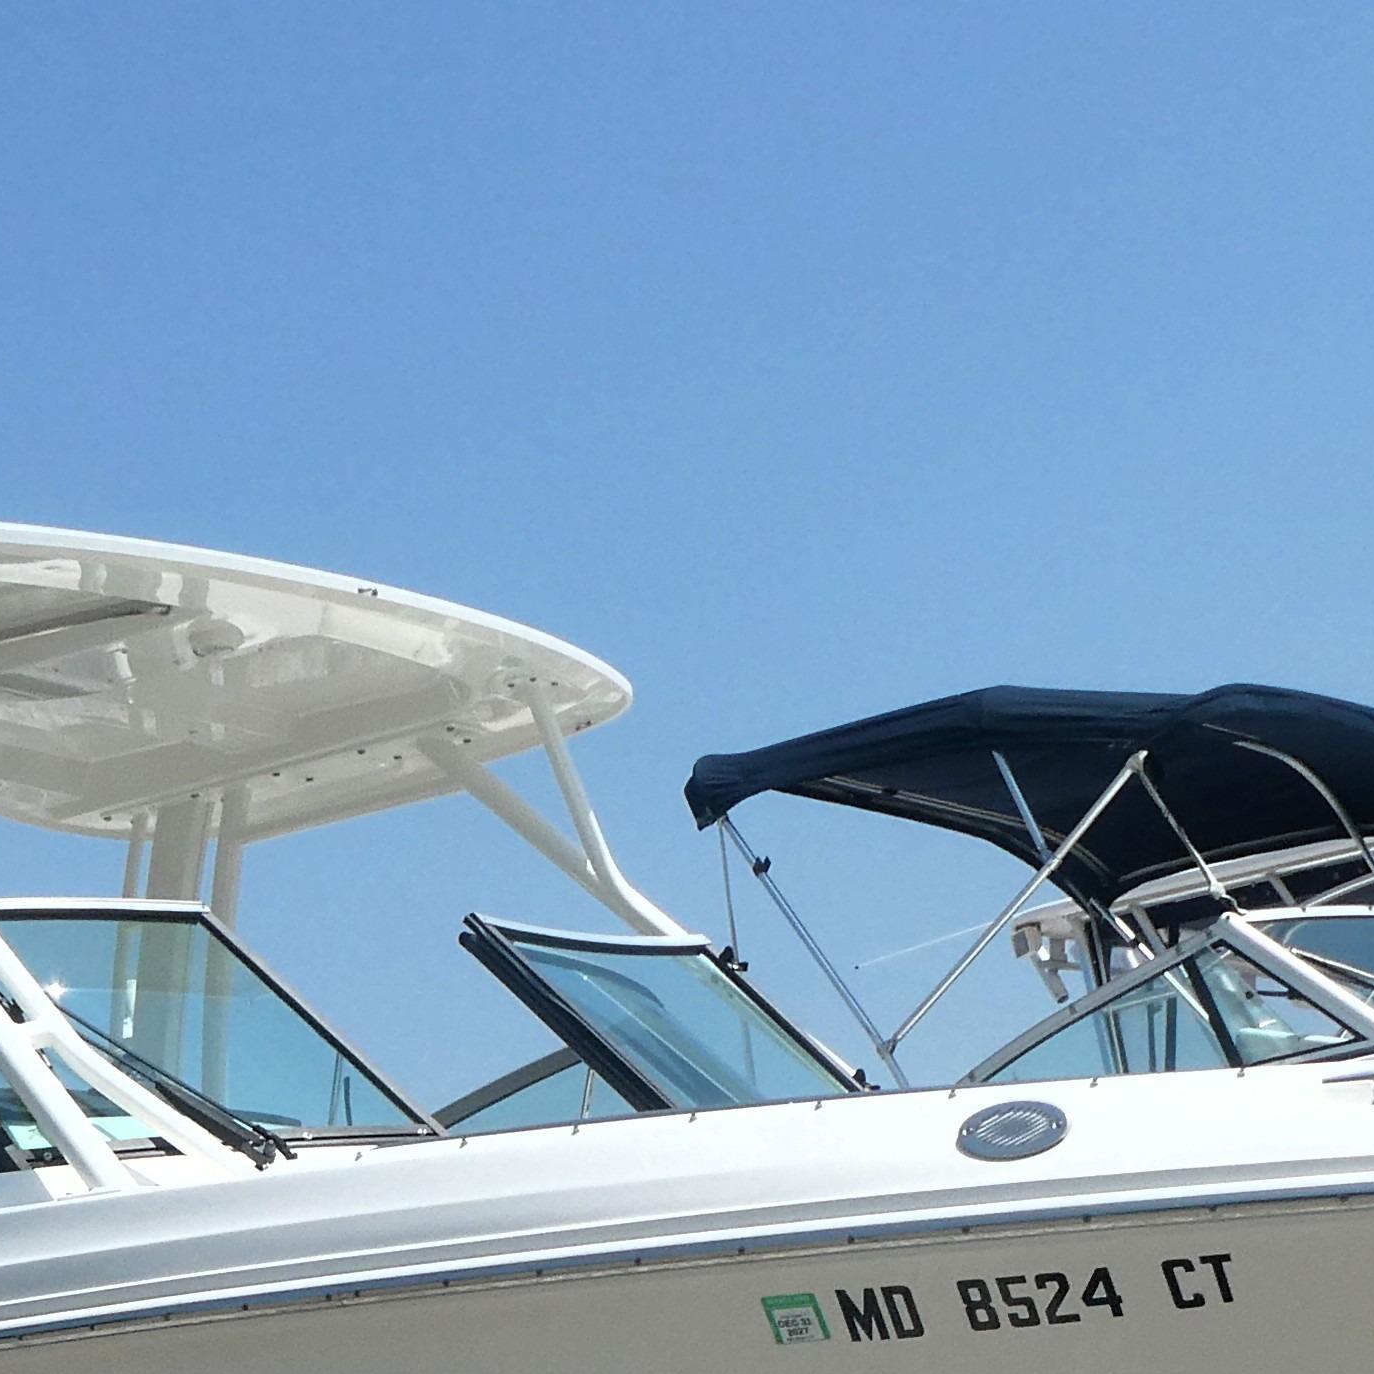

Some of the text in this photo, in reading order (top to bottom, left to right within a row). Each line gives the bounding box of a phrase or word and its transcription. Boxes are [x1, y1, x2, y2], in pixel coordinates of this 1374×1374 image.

[835, 1252, 1234, 1342] MD 8524 CT
